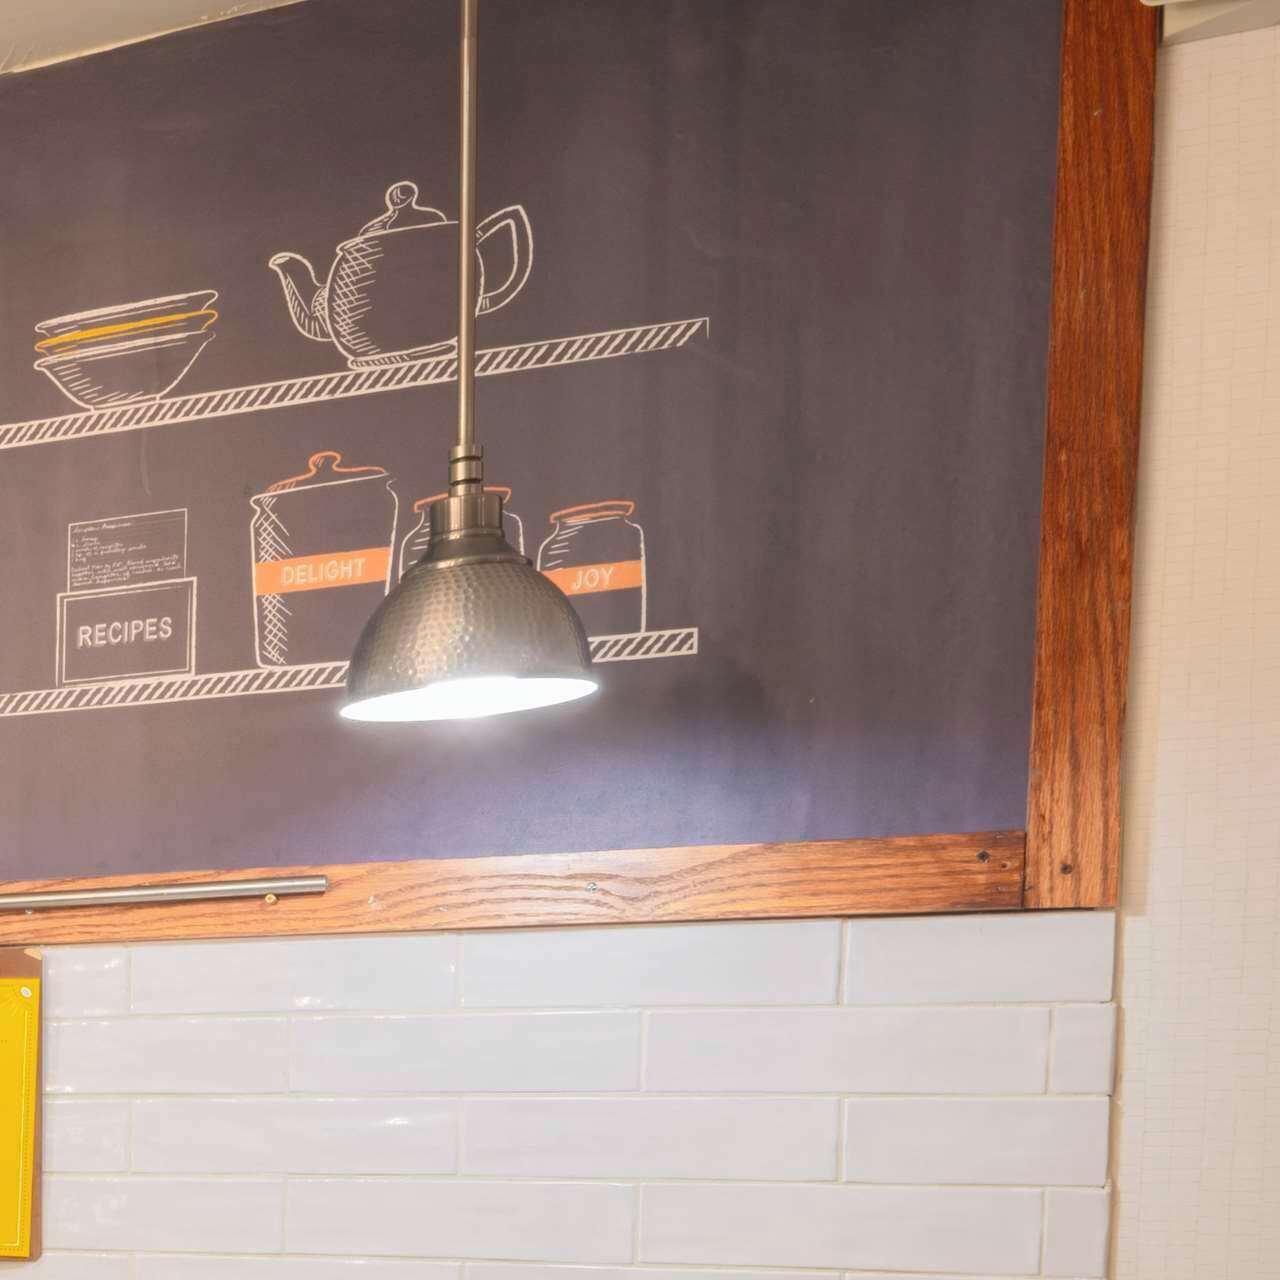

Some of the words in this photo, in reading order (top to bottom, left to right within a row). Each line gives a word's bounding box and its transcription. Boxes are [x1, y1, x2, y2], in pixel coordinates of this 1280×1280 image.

[280, 557, 367, 586] DELIGHT
[571, 567, 615, 591] JOY
[76, 616, 173, 650] RECIPES
